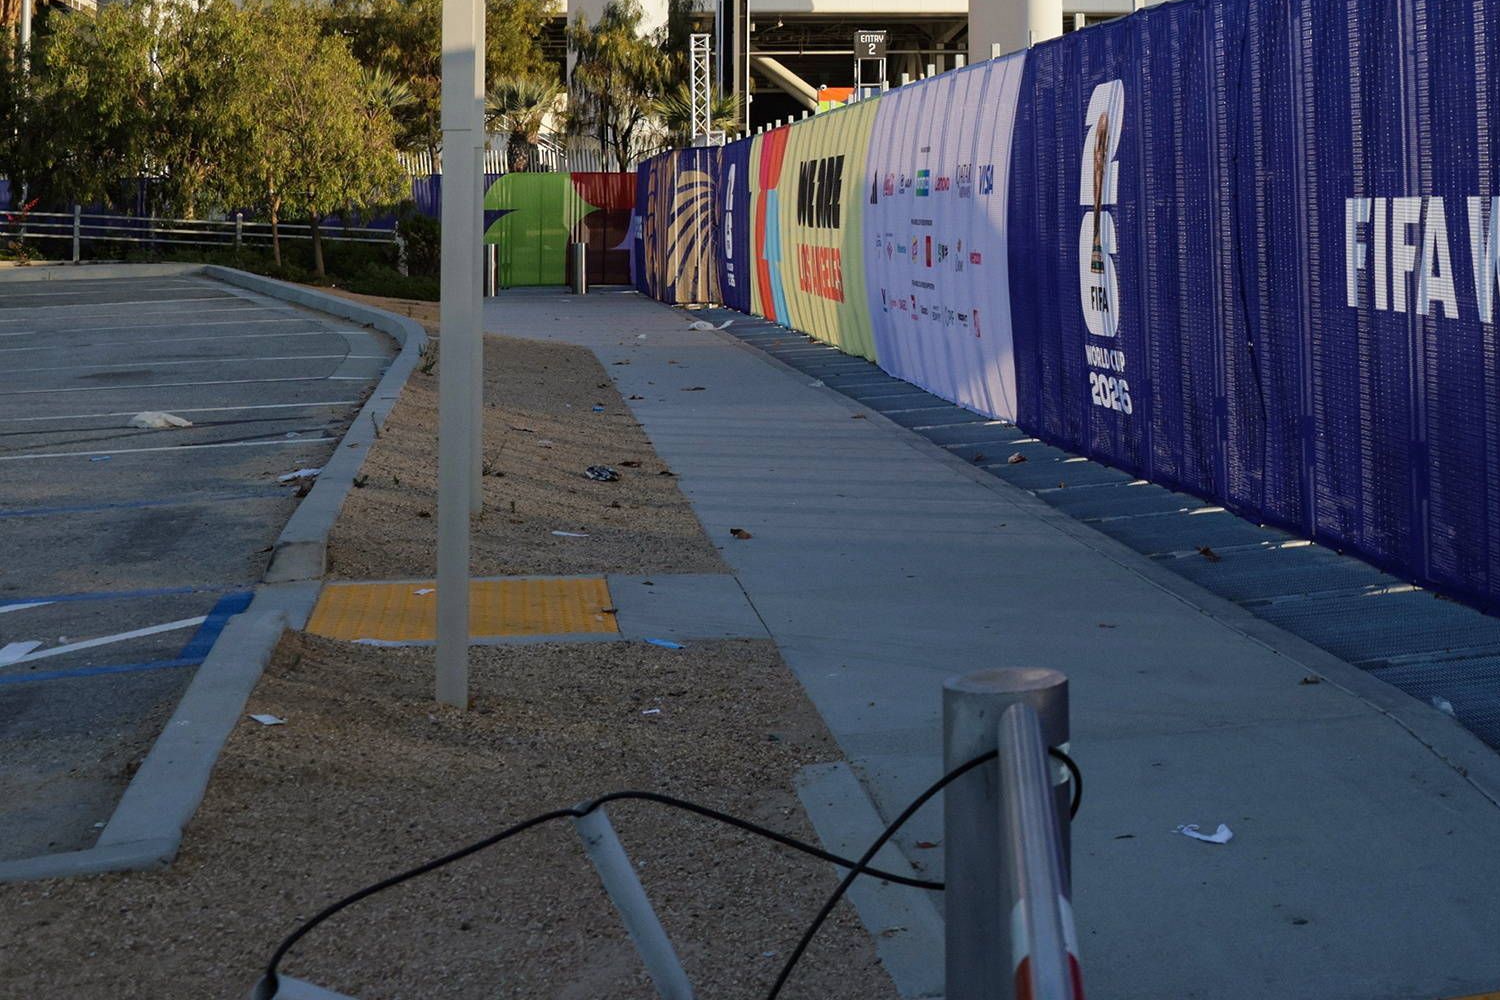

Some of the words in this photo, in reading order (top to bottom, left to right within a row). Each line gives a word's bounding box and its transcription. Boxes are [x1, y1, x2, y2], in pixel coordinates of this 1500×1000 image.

[860, 34, 884, 43] ENTRY
[868, 42, 876, 55] 2
[797, 159, 817, 229] WE
[816, 154, 845, 229] ARE
[979, 164, 994, 195] VISA
[1345, 195, 1460, 320] FIFA
[1090, 285, 1109, 314] FIFA
[1085, 344, 1110, 370] WORLD
[1110, 349, 1126, 374] CUP
[1089, 371, 1132, 415] 2026
